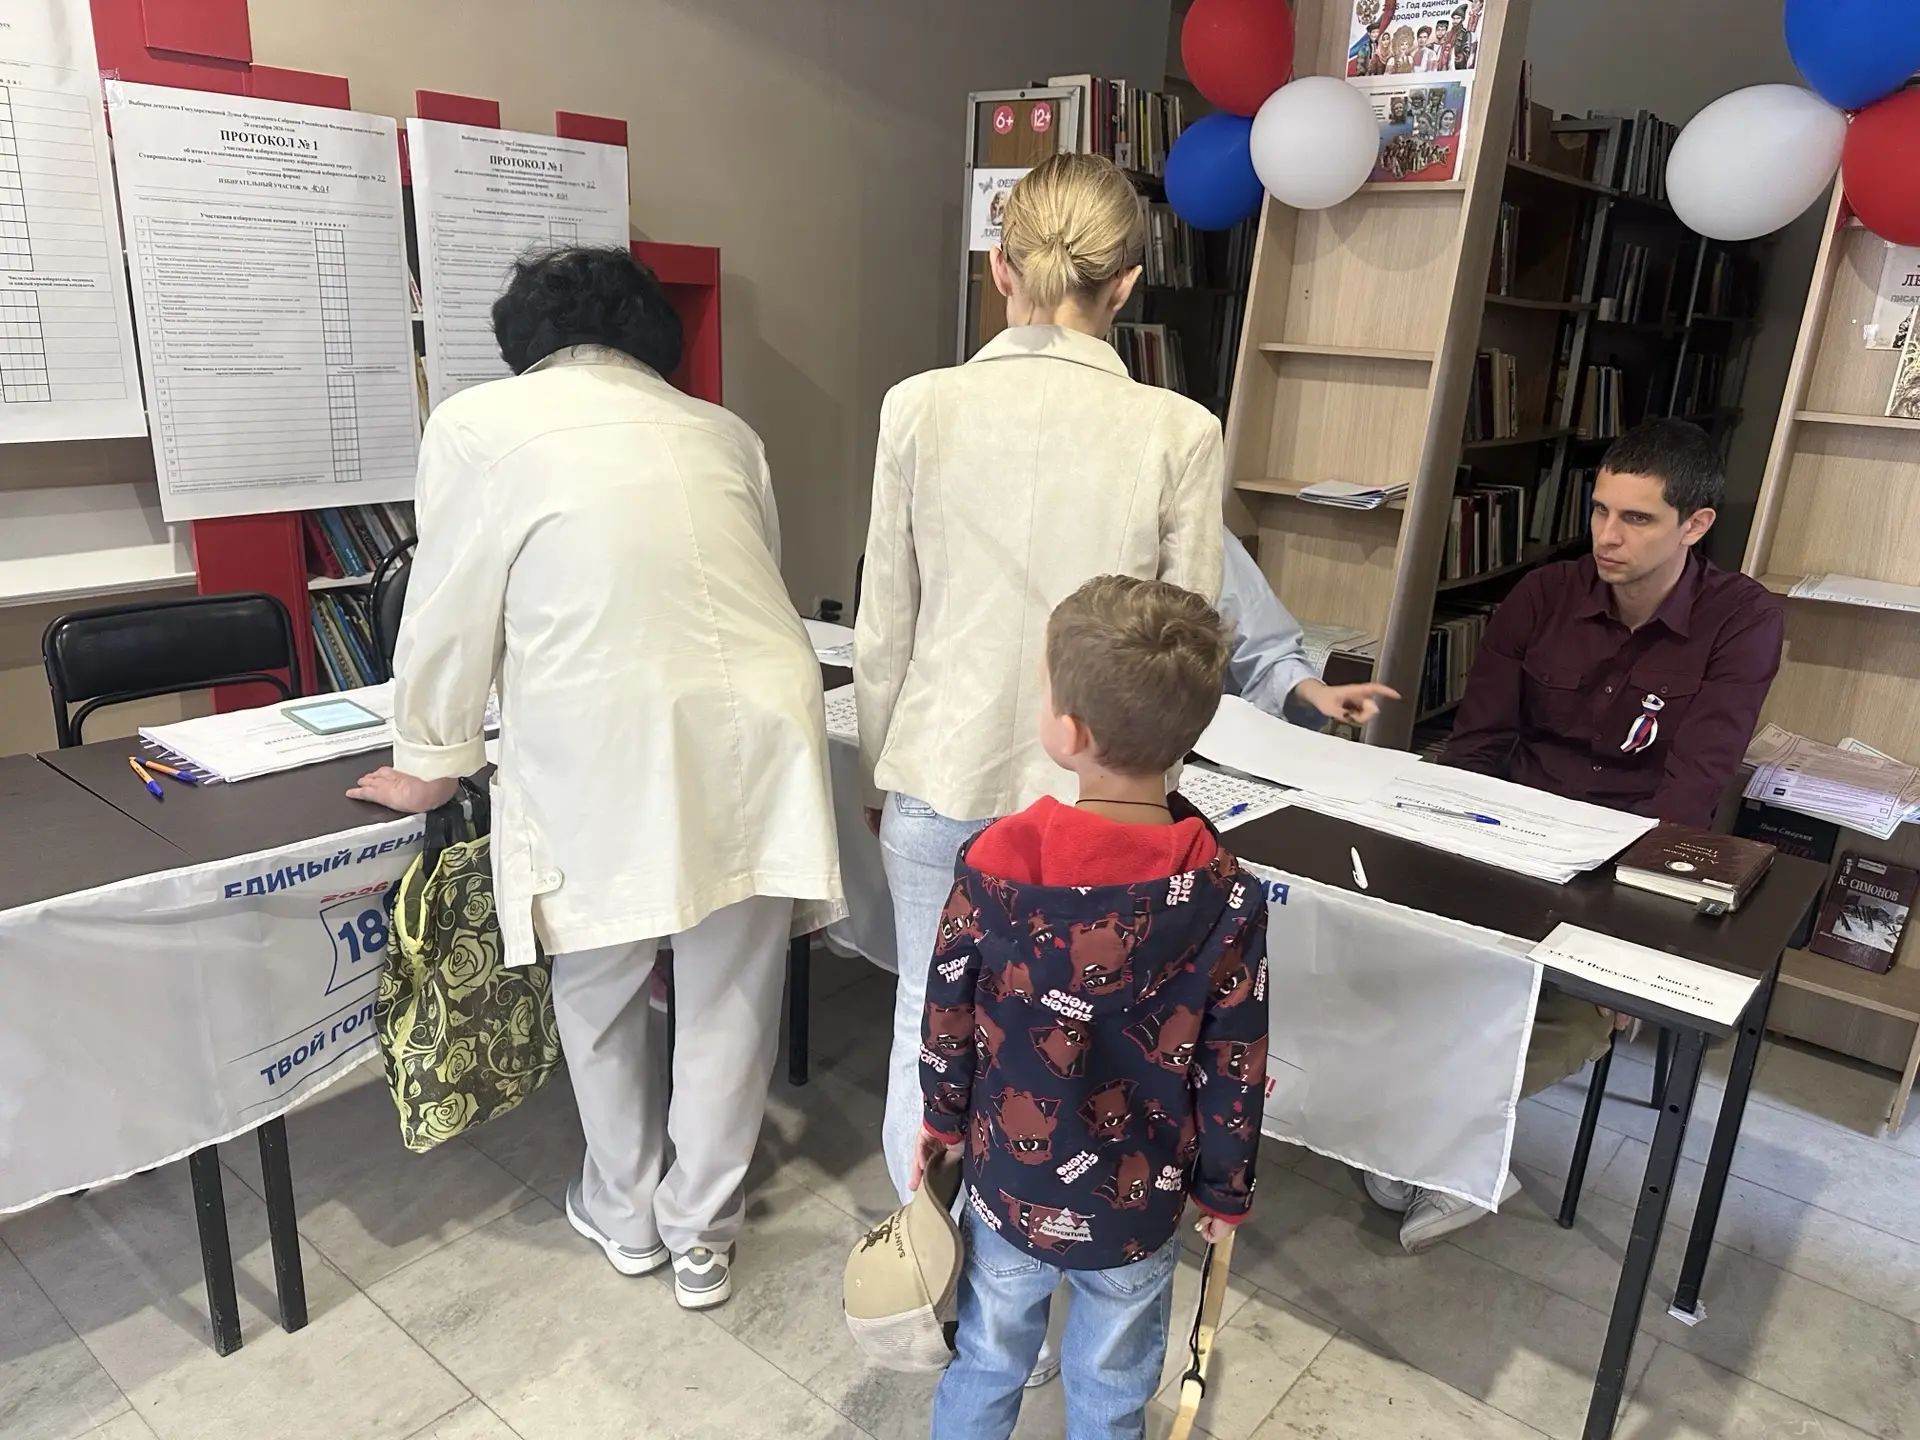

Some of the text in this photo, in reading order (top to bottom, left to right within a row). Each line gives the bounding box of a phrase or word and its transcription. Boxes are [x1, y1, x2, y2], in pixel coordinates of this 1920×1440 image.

[1422, 0, 1459, 8] единства
[1391, 10, 1451, 21] ародов России
[995, 112, 1014, 129] 6+
[1033, 109, 1051, 127] 12+
[220, 130, 318, 151] ПРОТОКОЛ № 1
[489, 155, 545, 170] ПРОТОКОЛ
[1891, 295, 1920, 303] ПИСАТ
[224, 849, 352, 899] ЕДИНЫЙ
[320, 880, 389, 904] 2026
[1838, 874, 1899, 902] К. СИМОНОВ
[1657, 974, 1690, 989] Книга
[260, 1002, 374, 1086] ТВОЙ ГОЛ
[1042, 1226, 1089, 1238] OUTVENTURE
[894, 1232, 906, 1258] SAINT
